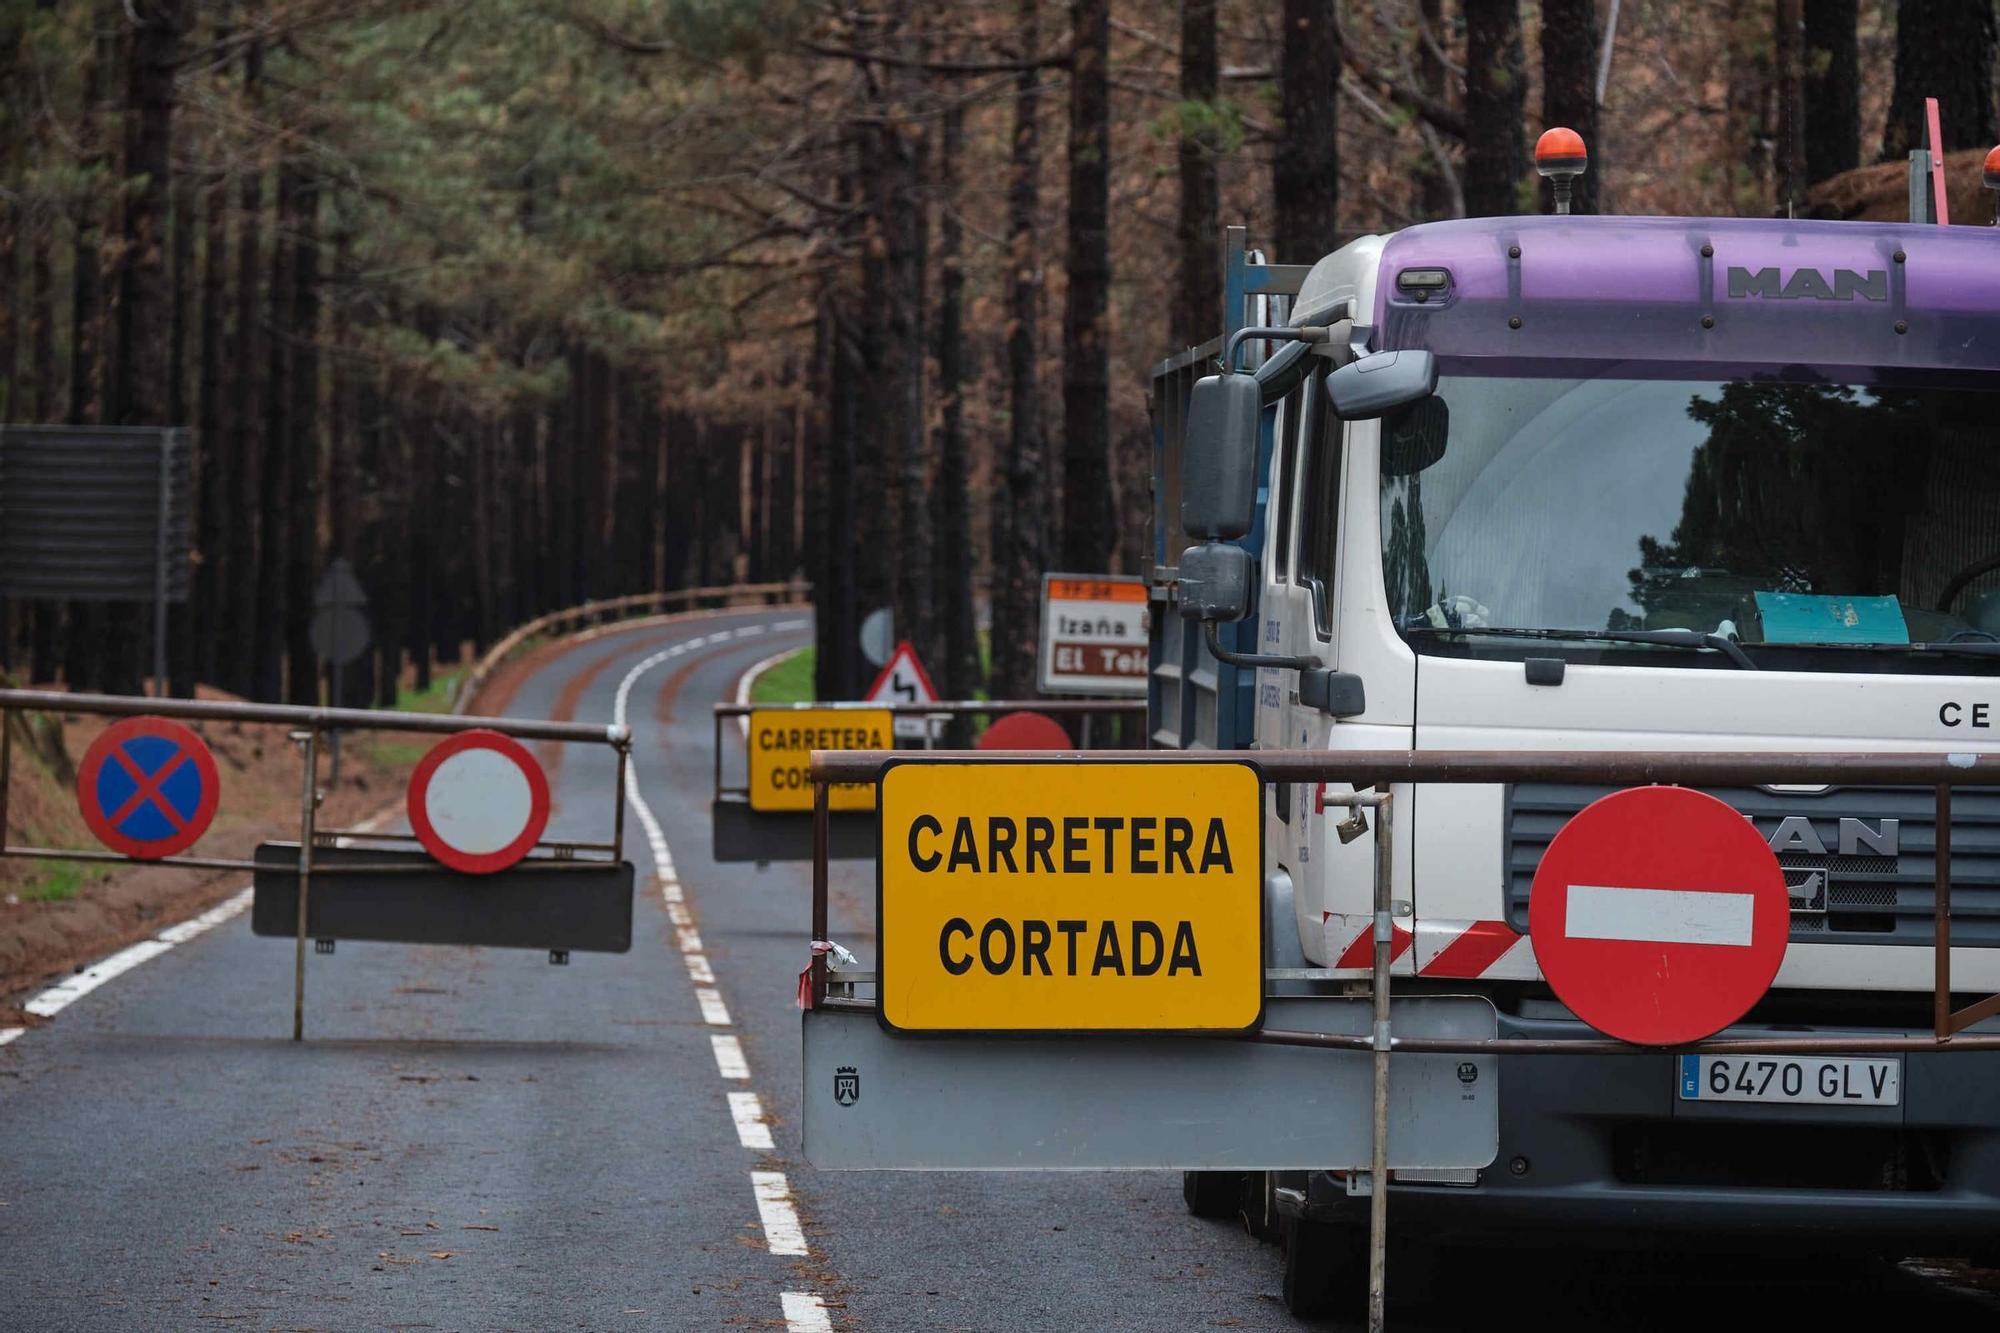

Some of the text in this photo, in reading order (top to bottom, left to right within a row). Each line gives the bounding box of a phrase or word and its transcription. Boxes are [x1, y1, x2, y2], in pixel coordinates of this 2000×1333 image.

[1727, 266, 1887, 301] MAN
[1056, 647, 1084, 672] El
[759, 729, 882, 751] CARRETERA
[908, 814, 1234, 874] CARRETERA
[1743, 816, 1899, 855] AN
[939, 917, 1202, 977] CORTADA
[1686, 1081, 1694, 1090] E
[1709, 1060, 1888, 1099] 6470 GLV
